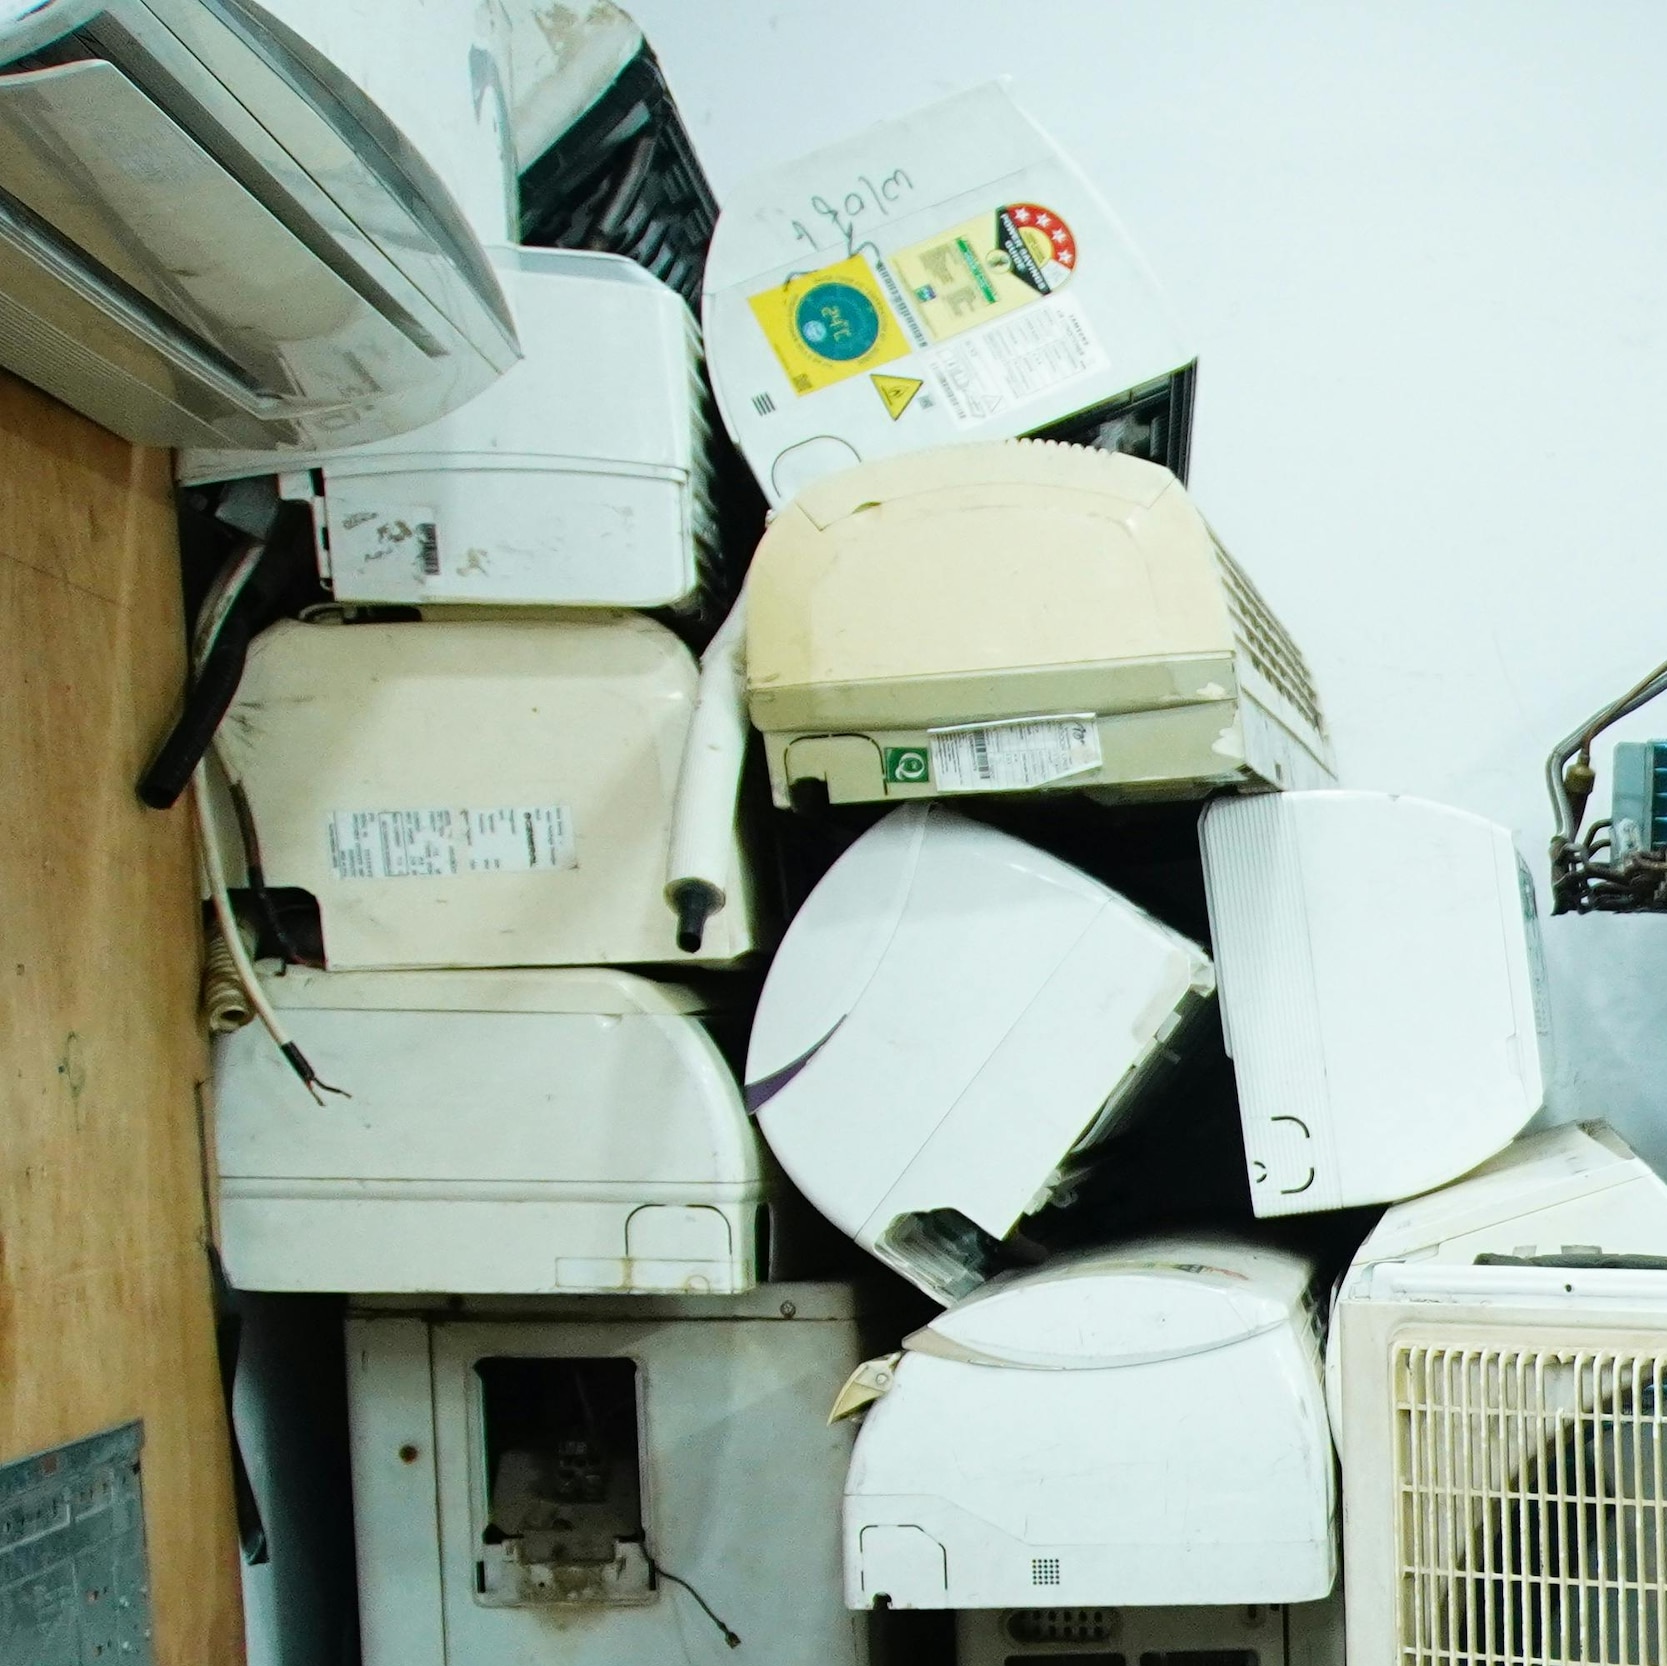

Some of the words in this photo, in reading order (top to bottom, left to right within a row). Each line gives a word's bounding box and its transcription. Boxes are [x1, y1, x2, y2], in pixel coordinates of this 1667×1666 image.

[1000, 212, 1021, 254] POWER
[1018, 248, 1047, 292] SAVINGS
[1004, 239, 1028, 274] GUIDE
